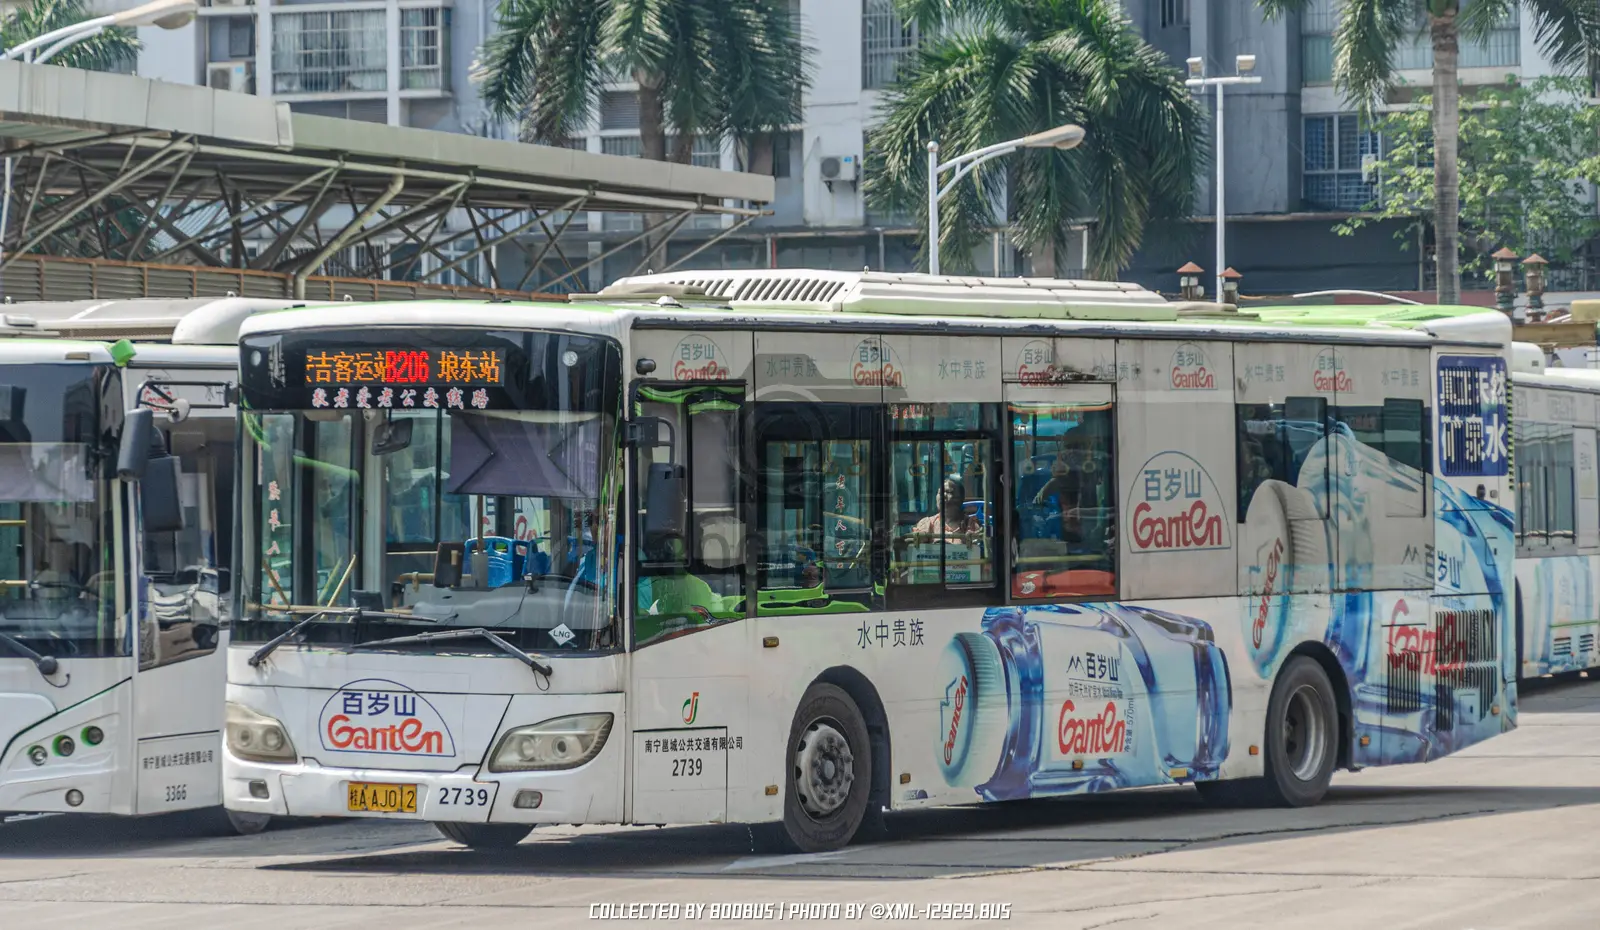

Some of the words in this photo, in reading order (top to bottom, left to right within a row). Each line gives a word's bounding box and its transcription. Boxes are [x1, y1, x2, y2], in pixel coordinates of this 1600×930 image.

[681, 344, 714, 360] 百岁山
[1024, 349, 1054, 364] 百岁山
[1177, 351, 1204, 366] 百岁山
[385, 351, 430, 383] B206
[767, 358, 818, 378] 水中贵族
[938, 359, 985, 380] 水中贵族
[1244, 364, 1285, 382] 水中贵族
[1172, 366, 1214, 389] Ganten
[1314, 370, 1353, 391] Ganten
[1381, 369, 1420, 387] 水中贵族
[1144, 468, 1202, 501] 百岁山
[1133, 500, 1222, 549] Ganten
[553, 630, 571, 639] LNG
[857, 618, 924, 649] 水中贵族
[1086, 652, 1119, 681] 百岁山
[342, 692, 415, 716] 百岁山
[327, 714, 443, 753] Ganten
[1058, 699, 1126, 755] Ganten
[644, 736, 743, 753] 南宁邕城公共交通有限公司
[672, 758, 703, 777] 2739
[165, 783, 187, 802] 3366
[438, 787, 489, 806] 2739
